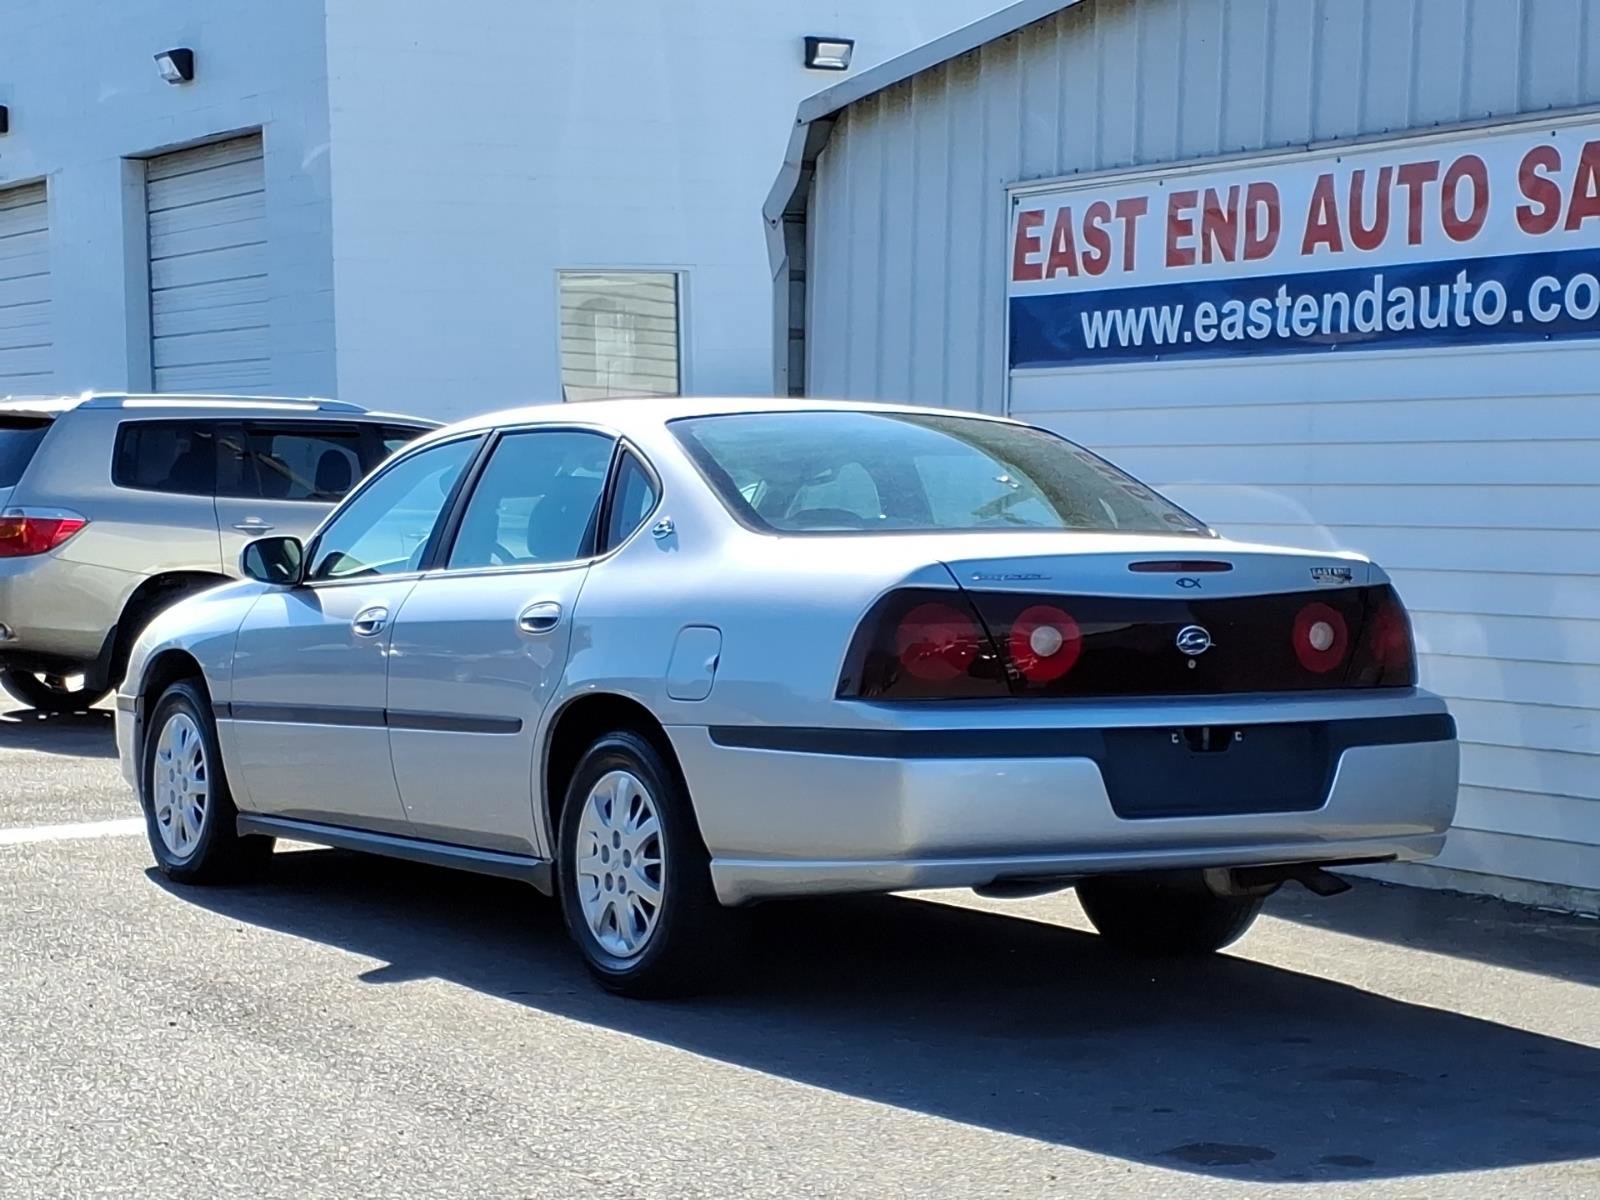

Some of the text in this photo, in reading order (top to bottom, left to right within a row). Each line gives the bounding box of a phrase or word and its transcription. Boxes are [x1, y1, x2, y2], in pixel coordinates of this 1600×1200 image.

[1012, 196, 1148, 281] EAST
[1165, 181, 1281, 267] END
[1301, 154, 1490, 256] AUTO
